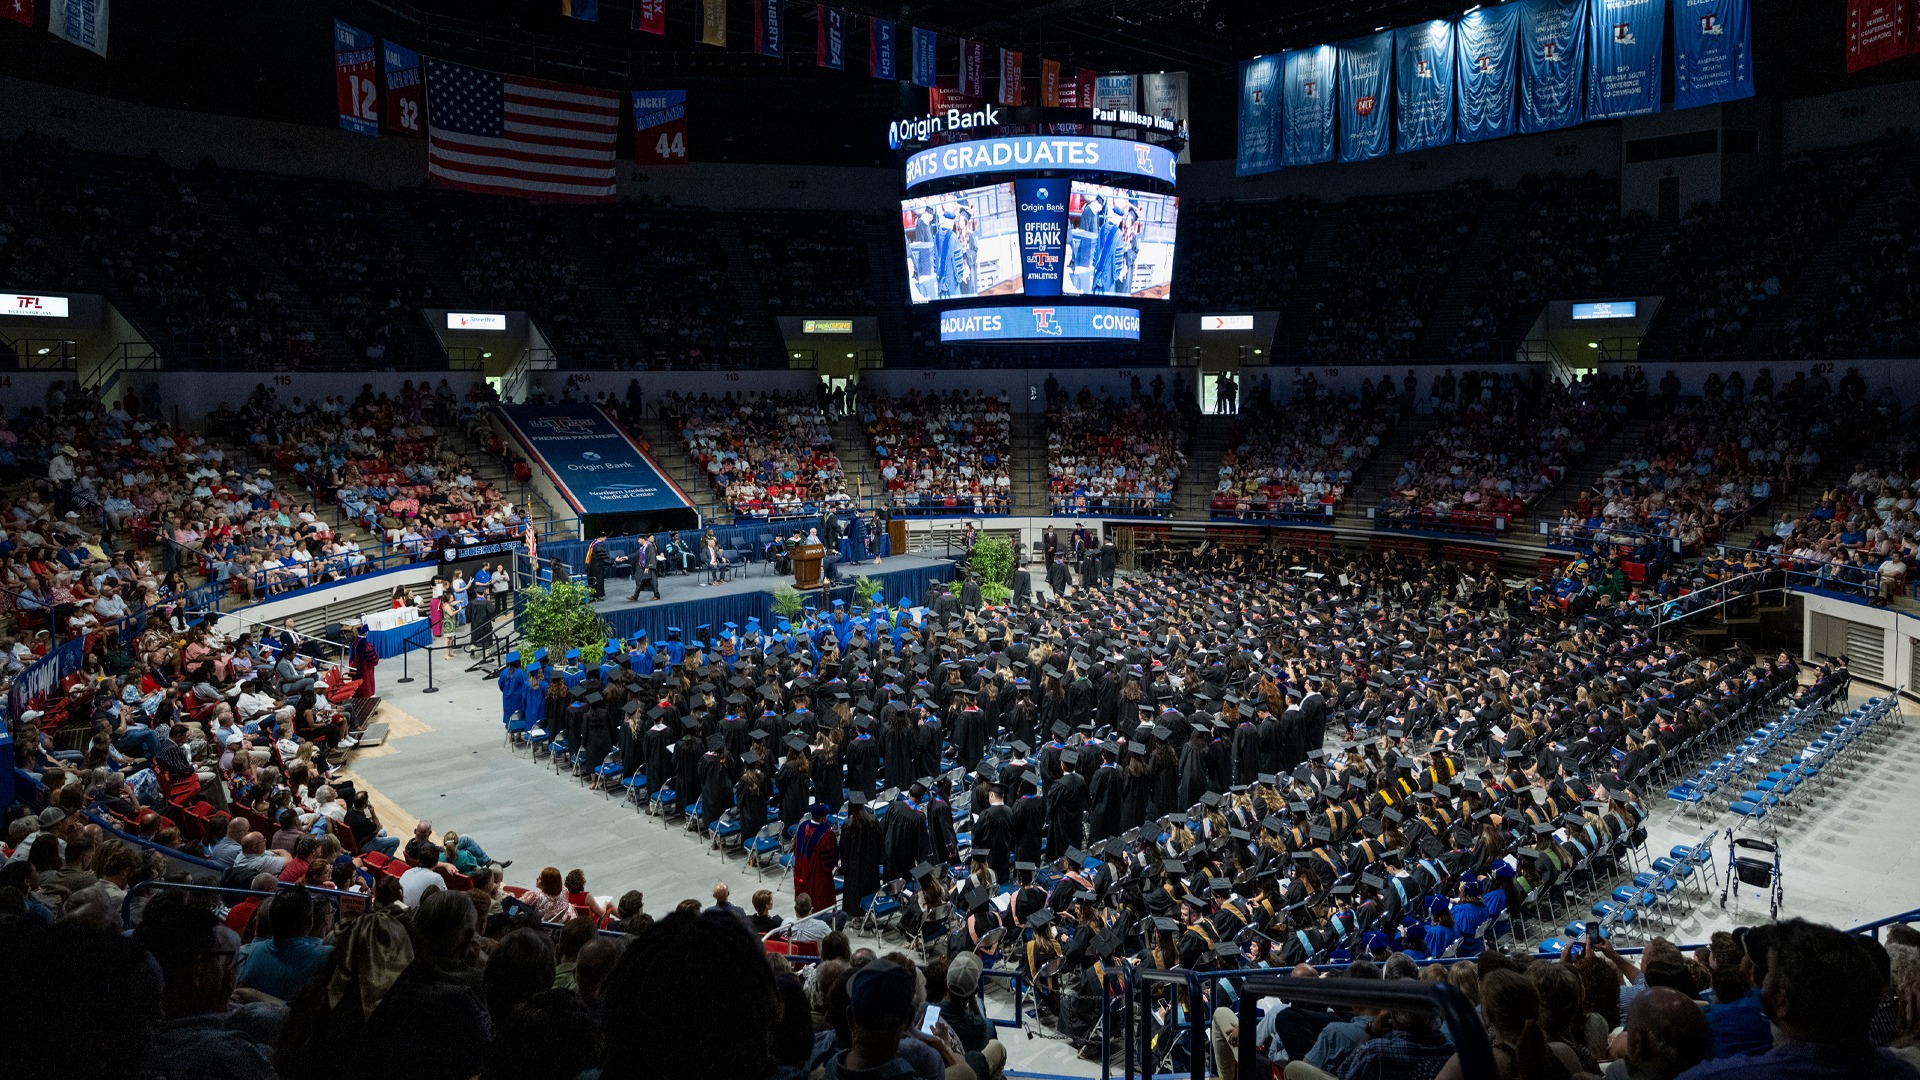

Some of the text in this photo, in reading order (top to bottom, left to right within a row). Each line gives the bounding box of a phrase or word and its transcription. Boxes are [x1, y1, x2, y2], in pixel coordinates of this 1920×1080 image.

[336, 28, 355, 47] LEON
[882, 43, 890, 75] TECH
[1628, 70, 1646, 80] SOUTH
[1098, 78, 1132, 88] BULLDOG
[1606, 79, 1640, 90] CONFERENCE
[1098, 87, 1132, 96] BASKETBALL
[349, 74, 378, 121] 12
[634, 97, 667, 108] JACKIE
[1357, 99, 1374, 110] NIT
[400, 97, 419, 131] 32
[1840, 105, 1866, 120] 201
[900, 113, 941, 141] Origin
[947, 104, 999, 130] Bank
[1092, 107, 1117, 122] Paul
[1119, 109, 1153, 129] Millsap
[1154, 115, 1175, 132] Vision
[656, 132, 687, 158] 44
[1554, 144, 1577, 157] 232
[942, 141, 1100, 171] GRADUATES
[1410, 160, 1428, 172] 231
[631, 173, 650, 183] 226
[1021, 202, 1065, 213] Origin Bank
[1025, 222, 1061, 232] OFFICIAL
[1025, 231, 1062, 246] BANK
[16, 296, 43, 309] TFL
[725, 373, 739, 382] 116
[923, 371, 937, 380] 117
[1323, 368, 1339, 377] 119
[273, 375, 292, 386] 115
[572, 433, 619, 441] PARTNERS
[567, 463, 604, 472] Origin
[630, 491, 656, 499] Center
[457, 543, 501, 559] LOUISIANA
